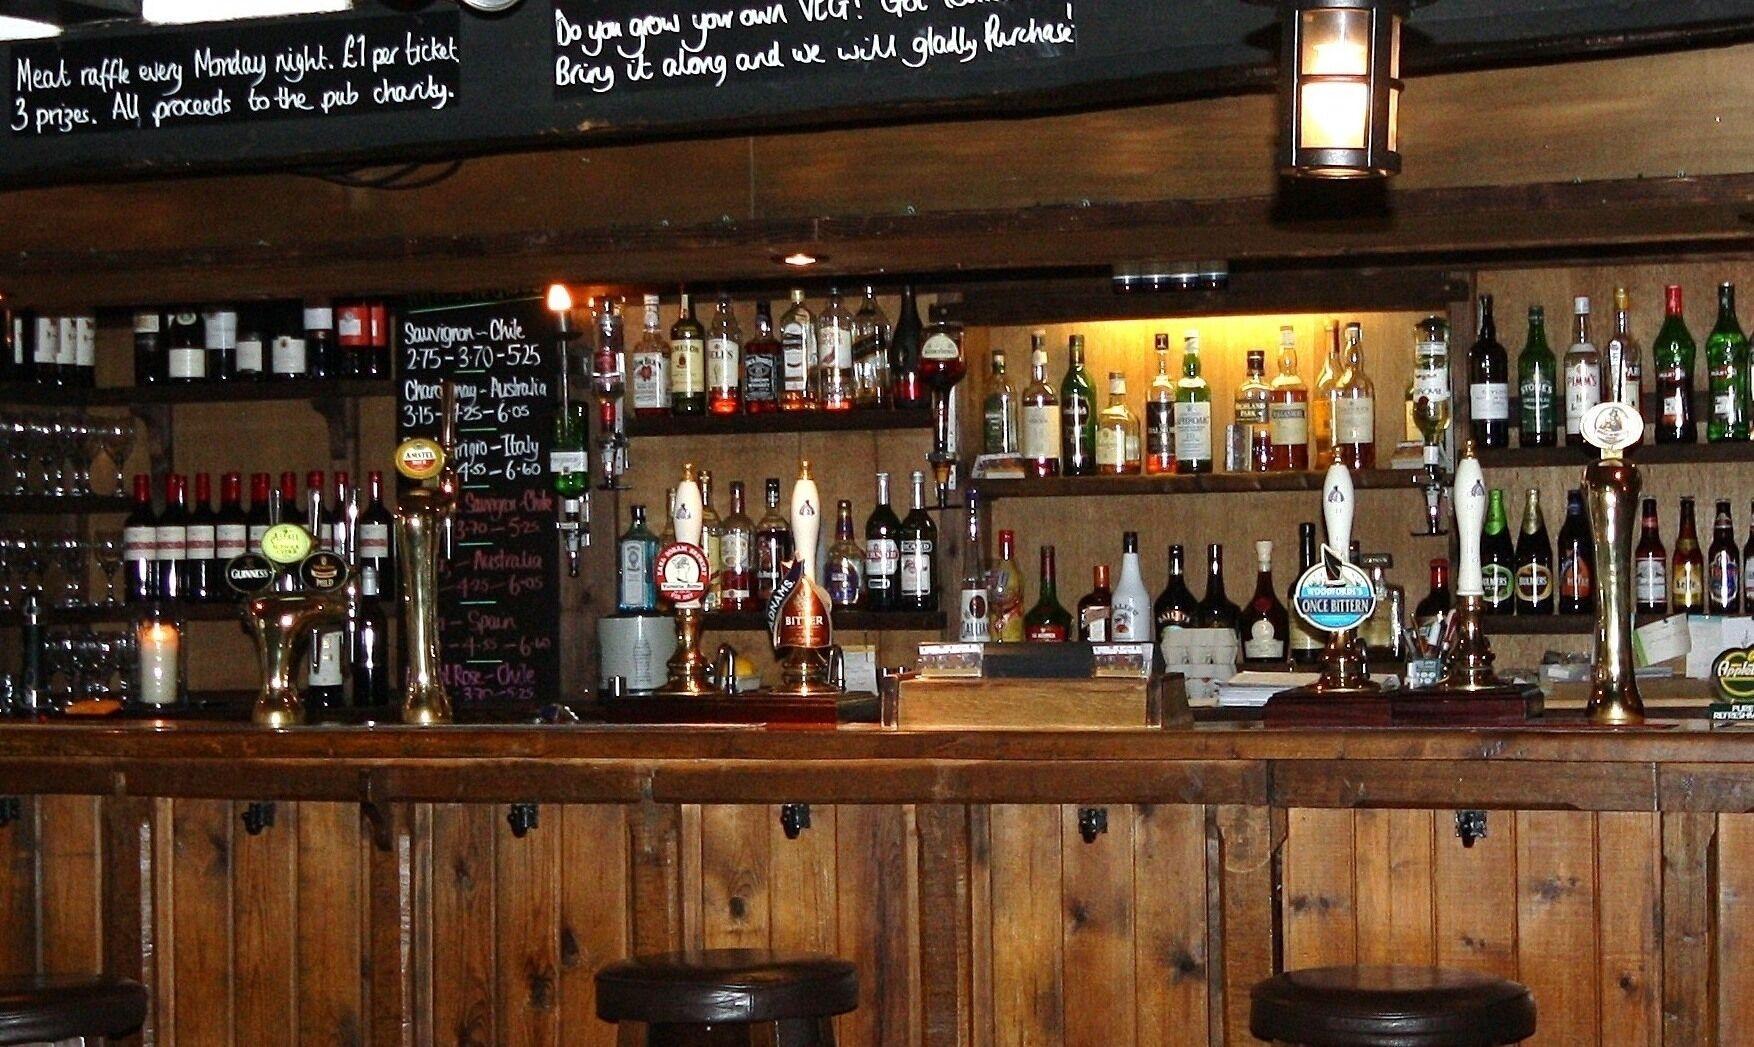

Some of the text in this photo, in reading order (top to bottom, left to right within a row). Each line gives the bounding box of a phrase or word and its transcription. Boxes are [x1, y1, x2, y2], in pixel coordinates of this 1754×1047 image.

[555, 8, 582, 46] Do
[581, 19, 623, 57] you
[617, 13, 680, 59] grow
[681, 10, 734, 53] your
[740, 3, 788, 25] own
[17, 58, 71, 92] Meat
[81, 57, 130, 93] raffle
[139, 60, 183, 97] every
[194, 47, 266, 87] Monday
[275, 44, 334, 83] night.
[342, 34, 366, 69] £1
[372, 46, 400, 73] per
[556, 55, 614, 92] Bring
[627, 53, 654, 81] it
[662, 48, 727, 87] along
[736, 41, 785, 71] and
[792, 44, 826, 63] we
[837, 35, 897, 61] will
[901, 26, 978, 68] gladly
[11, 97, 29, 131] 3
[36, 103, 98, 134] prizes.
[152, 88, 231, 128] proceeds
[249, 87, 271, 112] to
[273, 86, 315, 111] the
[320, 81, 360, 114] pub
[373, 74, 455, 110] charity.
[490, 318, 526, 341] Chile
[490, 376, 548, 398] Australia
[501, 433, 540, 462] Italy
[231, 569, 269, 579] GUINNESS
[1302, 598, 1369, 613] ONCE BITTERN
[785, 615, 824, 626] BITTER
